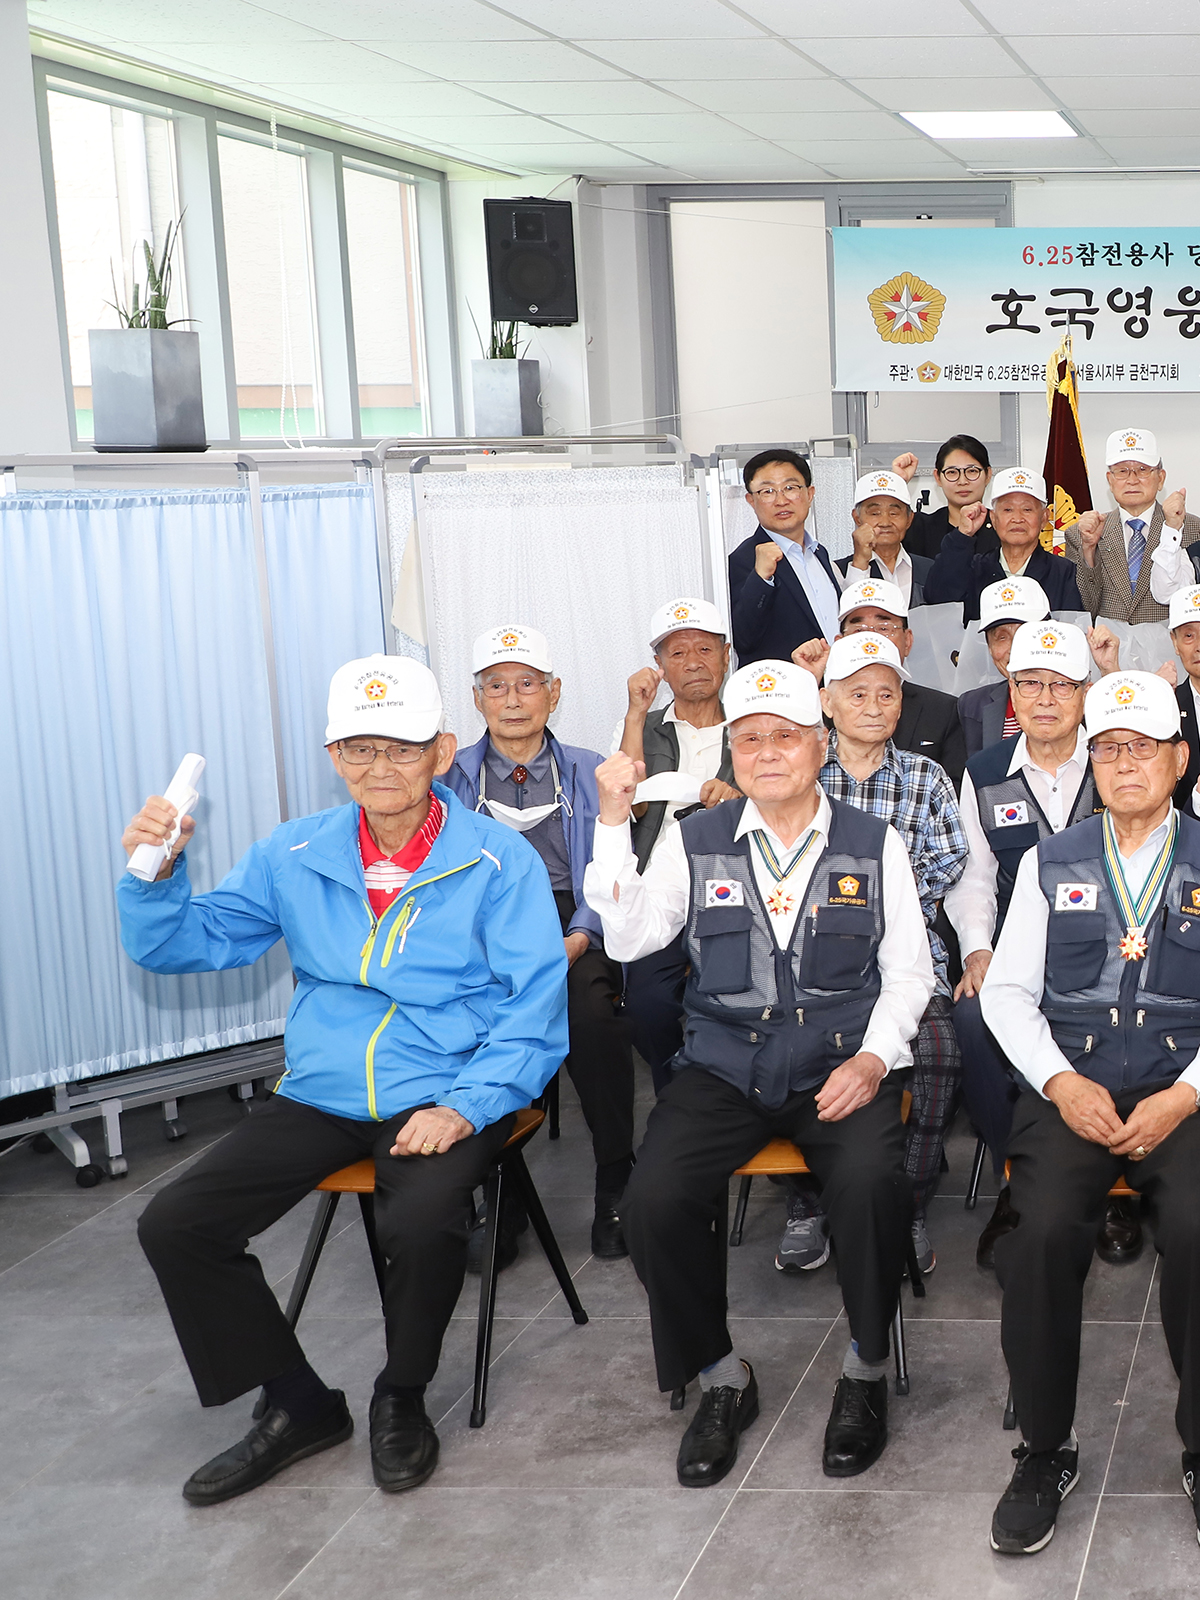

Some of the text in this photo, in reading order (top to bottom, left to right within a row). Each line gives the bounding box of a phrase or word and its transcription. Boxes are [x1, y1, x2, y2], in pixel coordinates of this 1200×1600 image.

[1022, 241, 1175, 268] 6.25참전용사
[889, 364, 914, 382] 주관:
[944, 364, 984, 381] 대한민국
[1076, 363, 1125, 381] 서울시지부
[1129, 363, 1180, 381] 금천구지회
